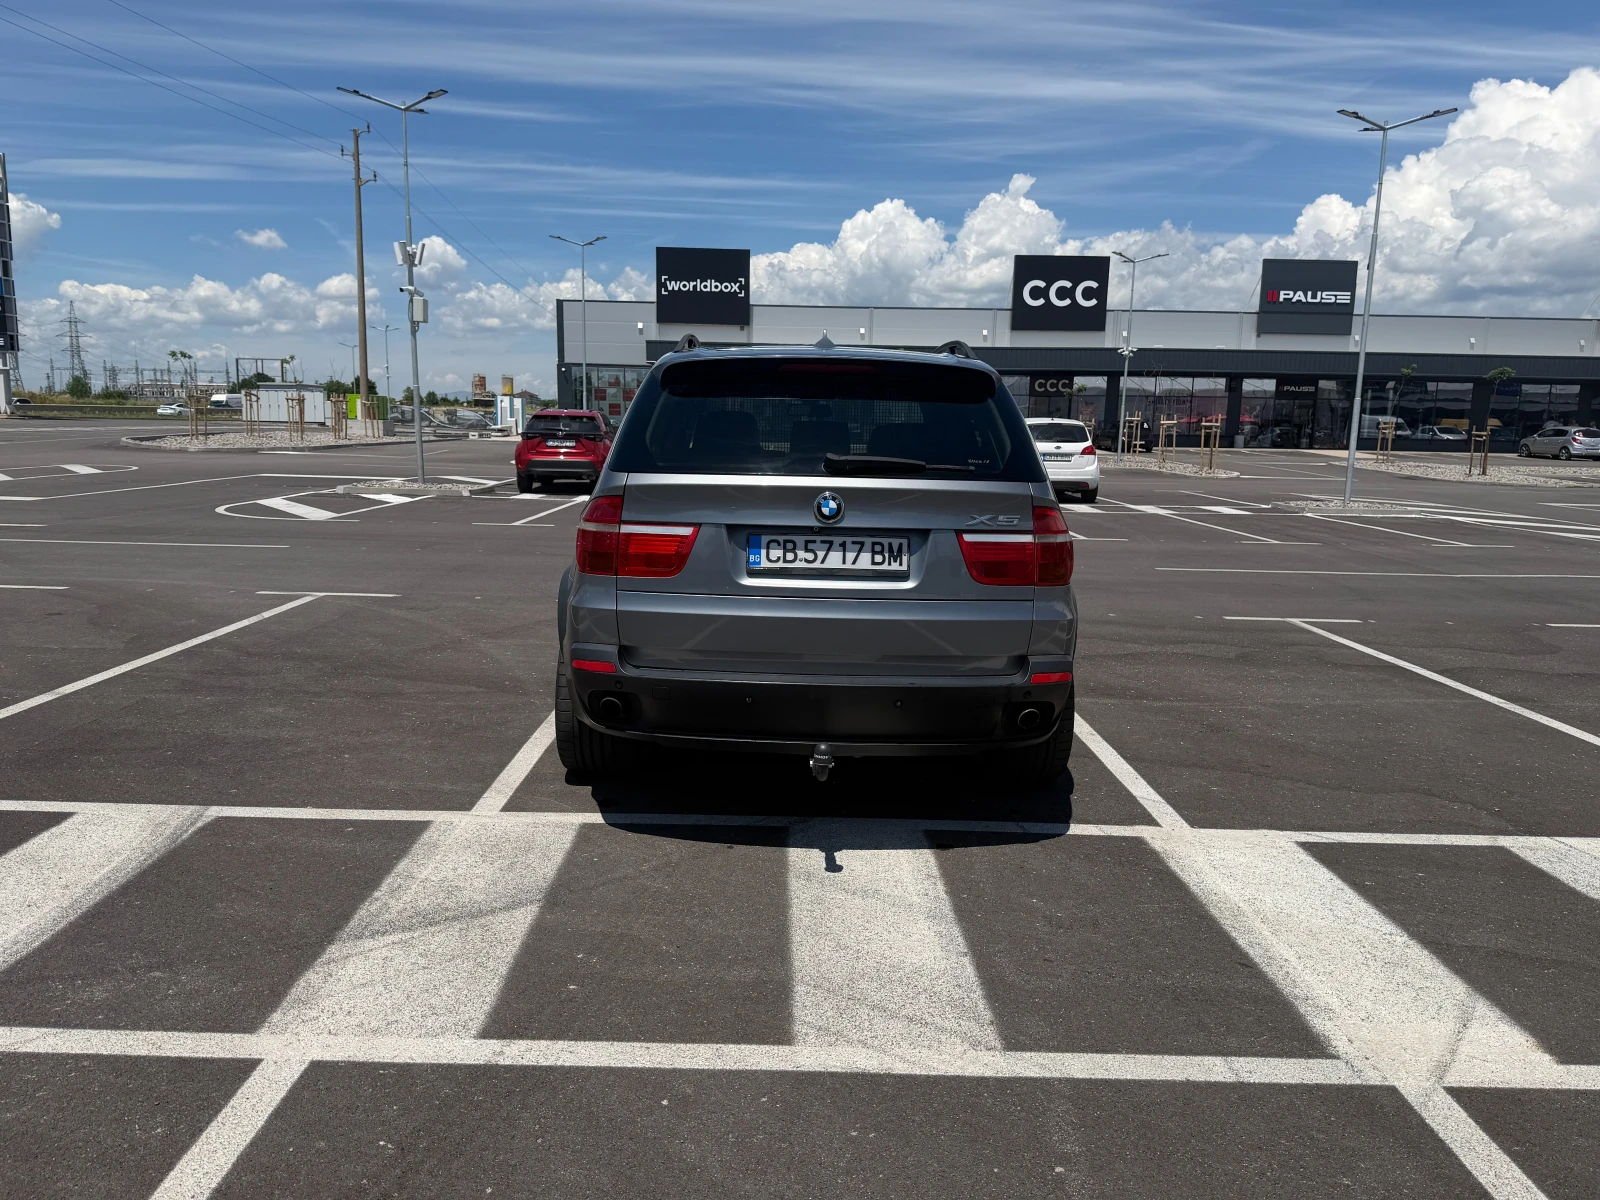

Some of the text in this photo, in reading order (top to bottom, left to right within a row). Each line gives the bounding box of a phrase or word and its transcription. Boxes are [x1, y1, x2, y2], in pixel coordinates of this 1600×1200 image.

[1022, 279, 1099, 307] CCC
[1279, 290, 1351, 303] PAUSE
[1034, 379, 1069, 392] CCC
[965, 514, 1020, 526] X5
[749, 554, 761, 563] BG
